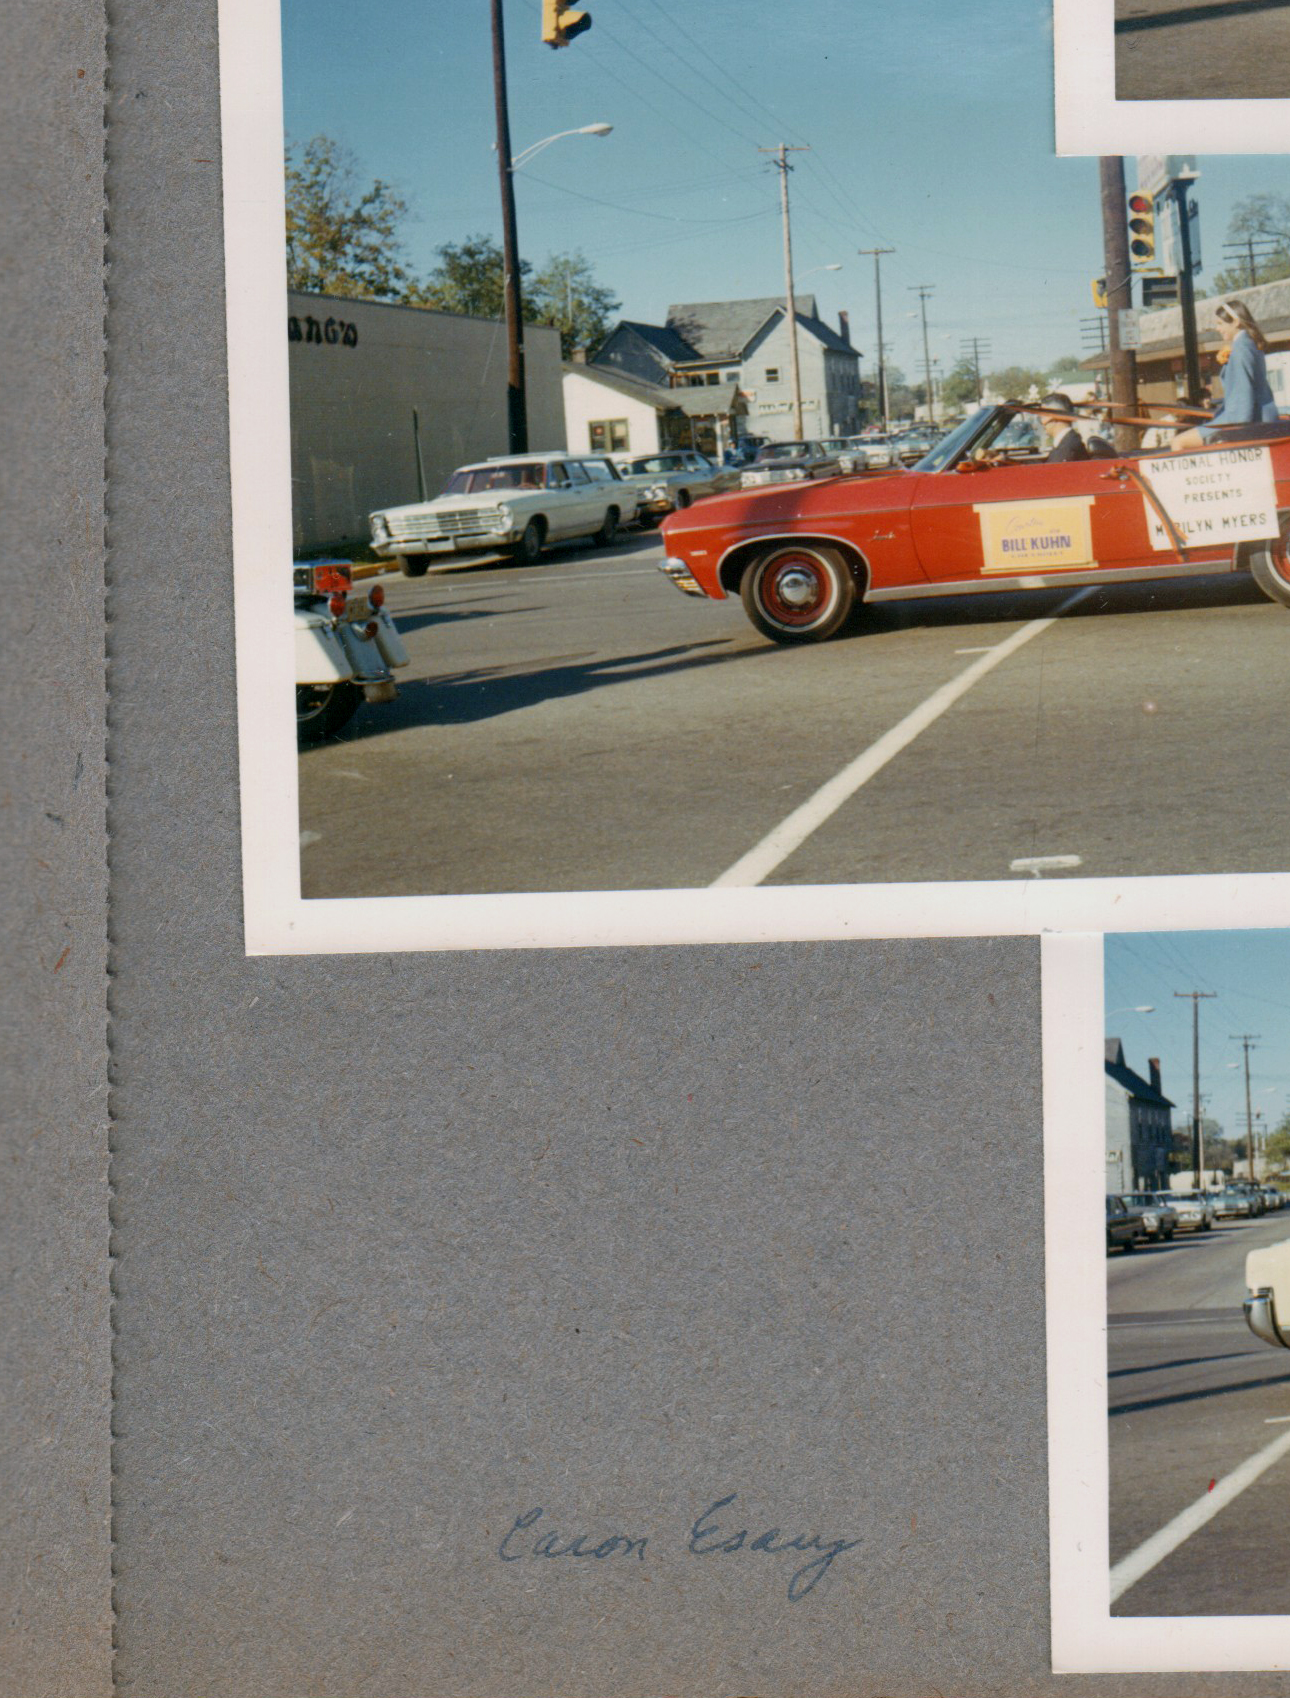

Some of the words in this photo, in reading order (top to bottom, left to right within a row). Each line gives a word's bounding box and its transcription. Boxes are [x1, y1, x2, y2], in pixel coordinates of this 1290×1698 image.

[1150, 455, 1213, 474] NATIONAL
[1219, 447, 1264, 466] HONOR
[1185, 473, 1232, 486] SOCIETY
[1184, 488, 1243, 504] PRESENTS
[1155, 518, 1213, 536] MRILYN
[1221, 513, 1268, 529] MYERS
[1001, 538, 1027, 552] BILL
[1030, 534, 1073, 551] KUHN
